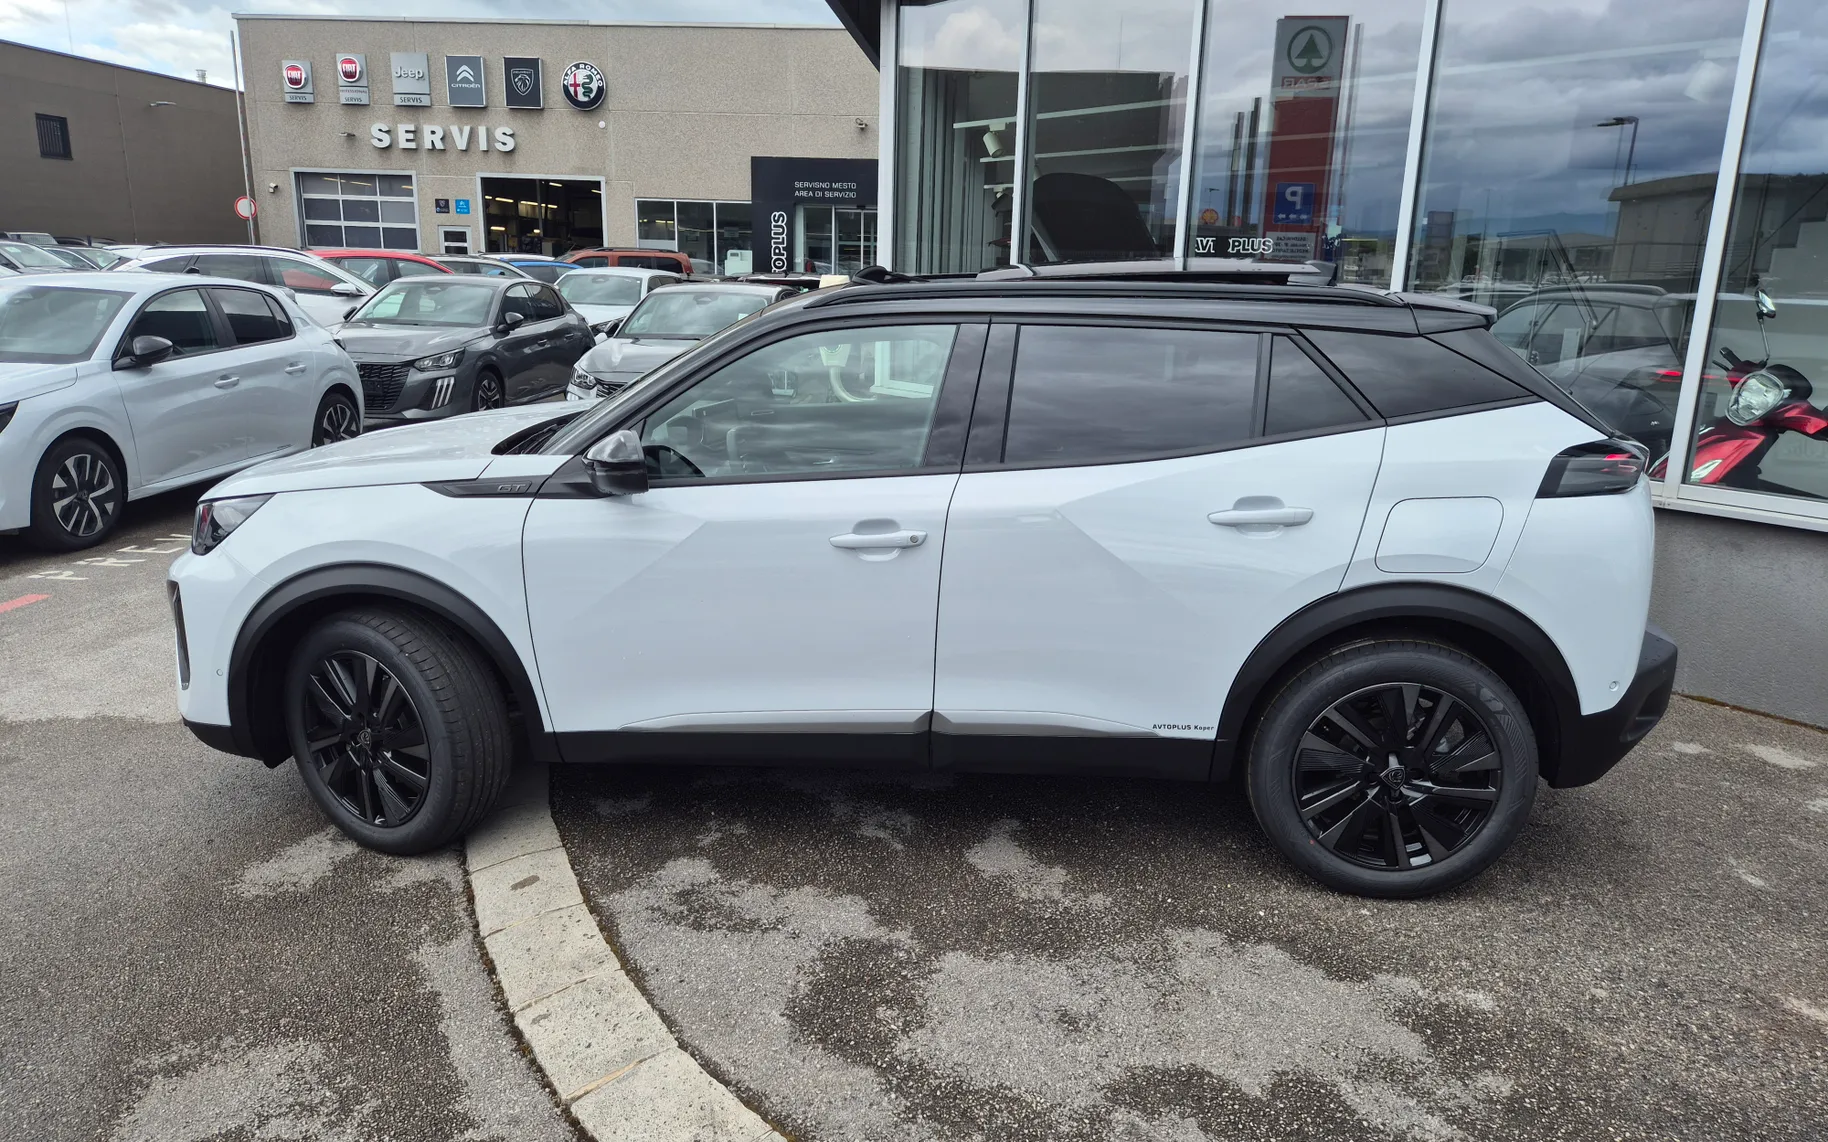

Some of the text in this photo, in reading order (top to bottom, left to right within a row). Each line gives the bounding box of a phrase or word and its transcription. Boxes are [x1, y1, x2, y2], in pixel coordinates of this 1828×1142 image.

[342, 63, 356, 71] FIAT
[287, 70, 302, 78] FIAT
[394, 66, 424, 79] Jeep
[563, 63, 603, 86] ALFA ROMEO
[370, 122, 516, 152] SERVIS
[794, 181, 830, 189] SERVISNO
[771, 211, 787, 272] OPLUS
[498, 484, 526, 492] GT
